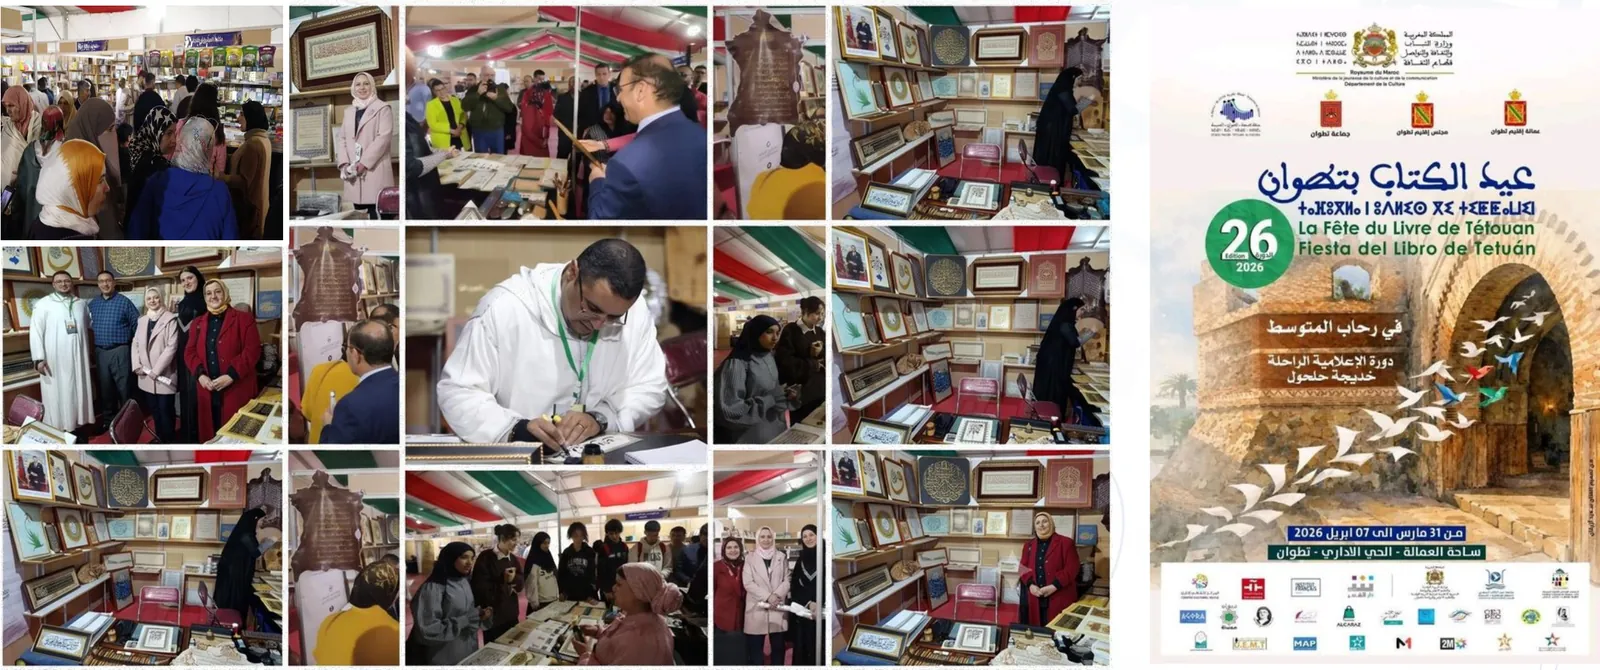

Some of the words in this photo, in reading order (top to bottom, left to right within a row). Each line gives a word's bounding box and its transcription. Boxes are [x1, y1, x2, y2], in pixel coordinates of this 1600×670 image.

[1310, 130, 1329, 138] تطوان
[1370, 161, 1468, 197] الكتاب
[1479, 161, 1536, 197] عيد
[1299, 221, 1318, 235] La
[1324, 220, 1360, 235] Fête
[1365, 221, 1387, 235] du
[1394, 221, 1432, 235] Livre
[1439, 221, 1460, 235] de
[1466, 219, 1534, 235] Tétouan
[1220, 218, 1278, 261] 26
[1299, 241, 1351, 256] Fiesta
[1358, 241, 1386, 256] del
[1394, 241, 1437, 256] Libro
[1444, 241, 1466, 256] de
[1473, 240, 1536, 256] Tetuán
[1236, 262, 1264, 272] 2026
[1266, 319, 1333, 337] المتوسط
[1337, 319, 1378, 337] رحاب
[1381, 319, 1402, 340] في
[1267, 355, 1310, 370] الراحلة
[1312, 354, 1367, 370] الإعلامية
[1369, 356, 1394, 370] دورة
[1287, 370, 1329, 385] حلحول
[1331, 370, 1376, 385] خديجة
[1294, 528, 1323, 538] 2026
[1326, 528, 1353, 541] ابريل
[1355, 528, 1369, 538] 07
[1372, 528, 1392, 538] الى
[1396, 528, 1427, 540] مارس
[1429, 528, 1440, 538] 31
[1443, 528, 1463, 541] من
[1276, 546, 1310, 559] تطوان
[1321, 546, 1360, 559] الاداري
[1364, 546, 1392, 559] الحي
[1403, 546, 1443, 557] العمالة
[1447, 546, 1481, 557] ساحة
[1181, 612, 1206, 620] AGORA
[1441, 639, 1454, 649] 2M
